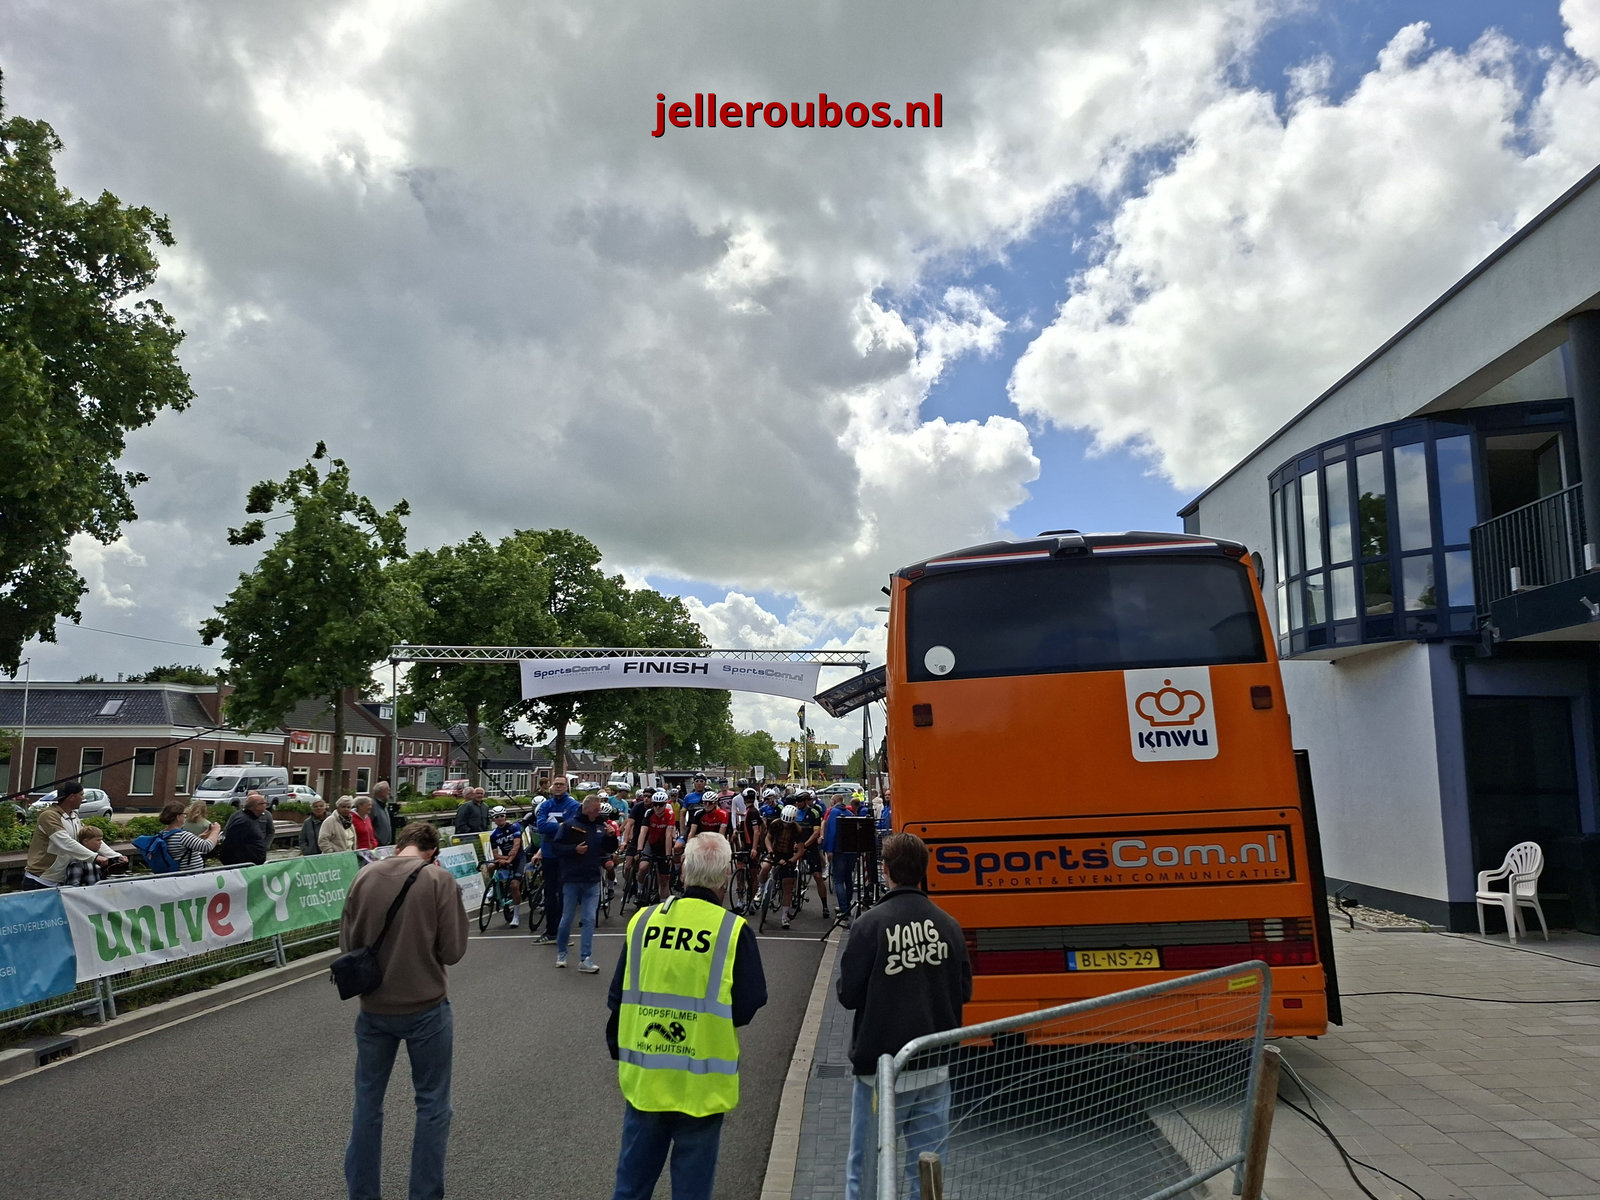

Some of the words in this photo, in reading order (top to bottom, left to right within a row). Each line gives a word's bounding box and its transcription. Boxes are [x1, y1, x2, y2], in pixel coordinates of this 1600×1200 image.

[533, 664, 611, 679] SportsCom.nl
[623, 661, 709, 675] FINISH
[722, 665, 804, 682] SportsCom.nl
[935, 834, 1278, 886] SportsCom.nl
[295, 868, 341, 889] Supporter
[987, 876, 1043, 887] SPORT
[1051, 876, 1059, 884] &
[1068, 874, 1123, 885] EVENT
[1132, 868, 1279, 882] COMMUNICATIE
[88, 875, 235, 962] univé
[643, 926, 713, 953] PERS
[885, 919, 939, 953] HANG
[638, 1006, 698, 1022] DORPSFILMER
[655, 1043, 696, 1057] HUITSING
